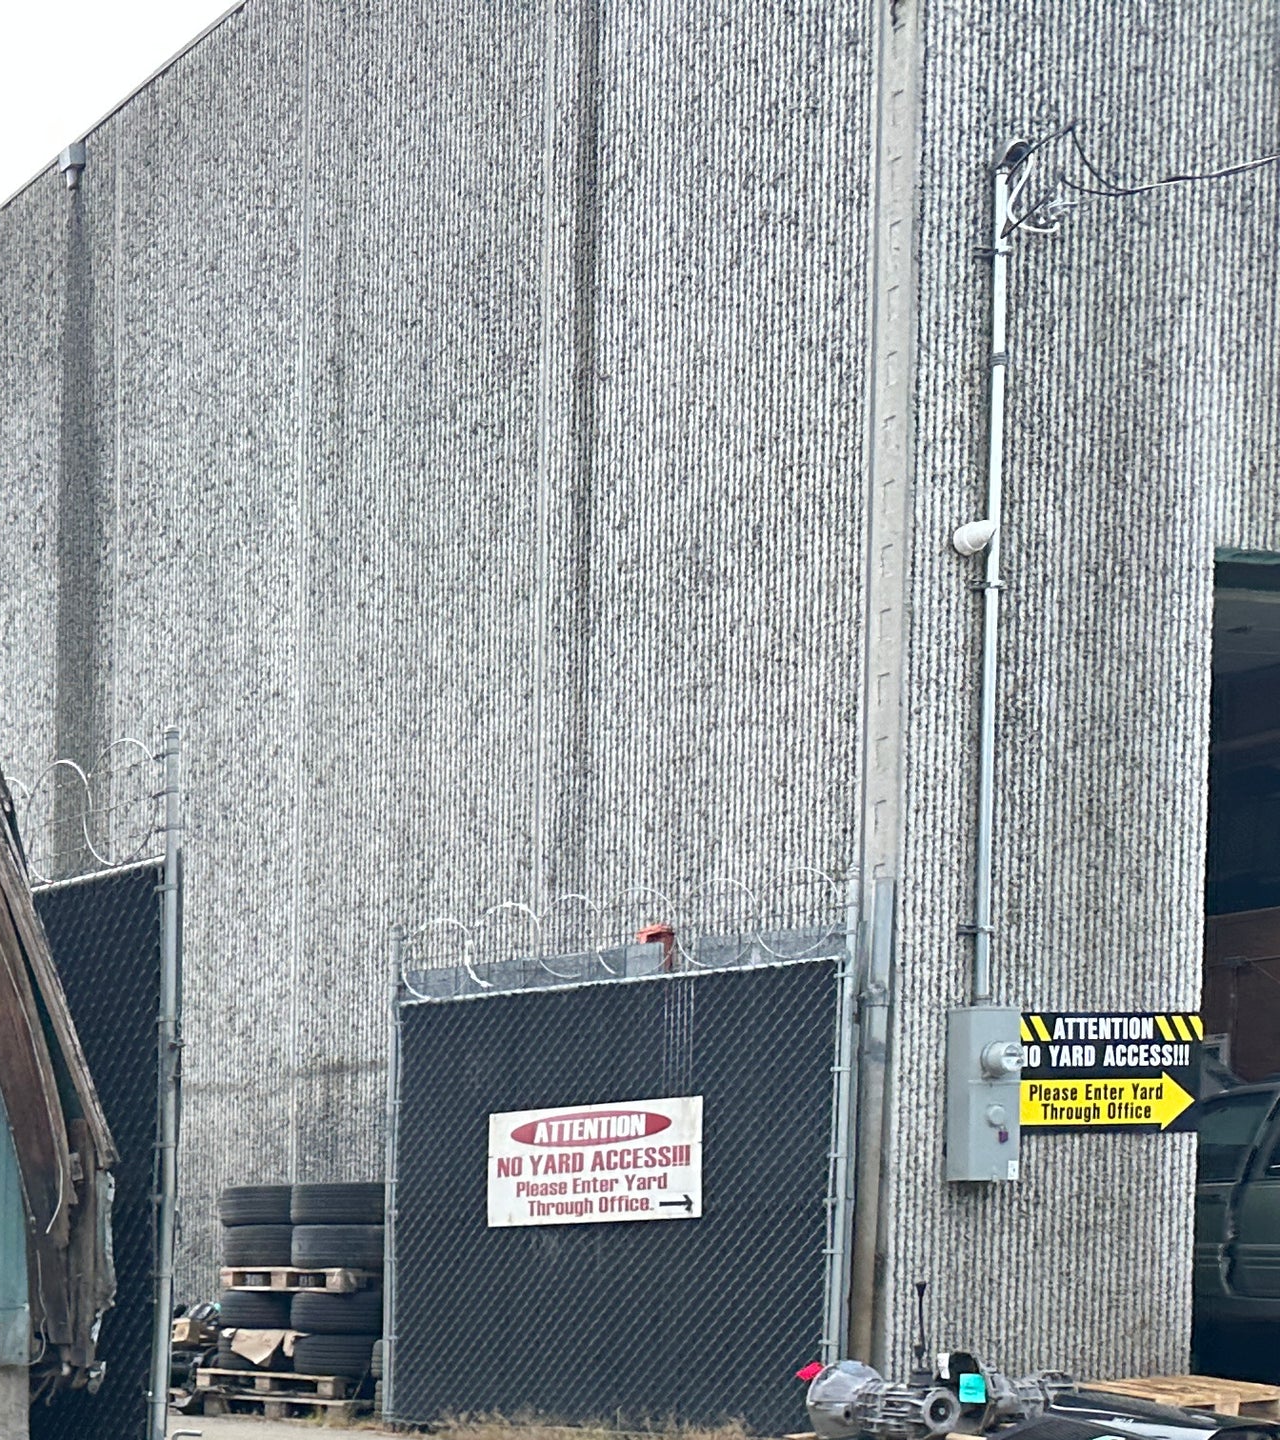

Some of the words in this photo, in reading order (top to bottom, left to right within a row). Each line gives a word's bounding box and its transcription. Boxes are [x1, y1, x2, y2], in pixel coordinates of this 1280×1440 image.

[1053, 1017, 1154, 1039] ATTENTION
[1048, 1044, 1096, 1067] YARD
[1103, 1044, 1190, 1067] ACCESS!!!
[1029, 1084, 1078, 1102] Please
[1085, 1084, 1125, 1101] Enter
[1131, 1083, 1163, 1100] Yard
[1041, 1103, 1100, 1122] Through
[1107, 1102, 1152, 1118] Office
[533, 1113, 647, 1144] ATTENTION
[496, 1156, 523, 1178] NO
[529, 1152, 585, 1176] YARD
[590, 1144, 692, 1171] ACCESS!!!
[516, 1179, 568, 1198] Please
[572, 1176, 619, 1195] Enter
[624, 1172, 668, 1190] Yard
[527, 1197, 594, 1217] Through
